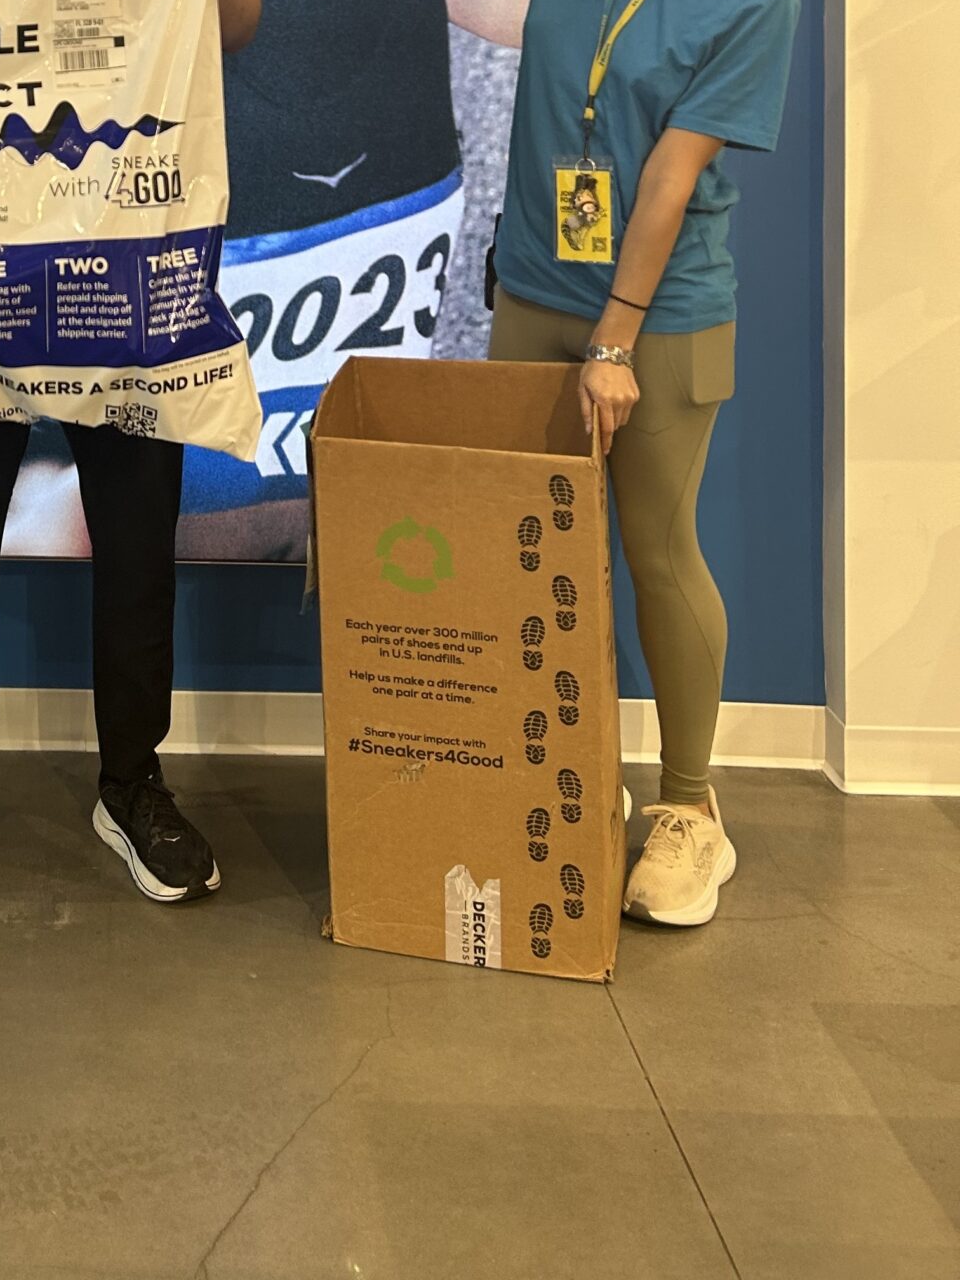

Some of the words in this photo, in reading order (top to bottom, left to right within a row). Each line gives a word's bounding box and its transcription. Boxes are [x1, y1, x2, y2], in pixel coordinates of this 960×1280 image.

[49, 176, 100, 197] with
[55, 256, 109, 275] TWO
[147, 248, 199, 273] TREE
[11, 284, 31, 294] with
[57, 281, 80, 291] Refer
[82, 281, 92, 290] to
[94, 281, 109, 291] the
[12, 295, 21, 304] of
[57, 293, 90, 303] prepaid
[92, 293, 128, 304] shipping
[16, 306, 37, 315] used
[57, 305, 78, 314] label
[80, 305, 96, 314] and
[99, 305, 119, 316] drop
[121, 304, 132, 313] off
[57, 317, 66, 326] at
[68, 317, 83, 326] the
[85, 316, 132, 328] designated
[57, 328, 95, 339] shipping
[89, 382, 103, 395] A
[109, 376, 188, 395] SECOND
[193, 363, 233, 387] LIFE!
[345, 619, 373, 630] Each
[375, 623, 401, 633] year
[404, 627, 430, 635] over
[433, 627, 458, 638] 300
[461, 631, 498, 642] million
[361, 635, 390, 644] pairs
[393, 637, 404, 646] of
[407, 639, 440, 649] shoes
[442, 642, 465, 652] end
[467, 646, 482, 655] up
[379, 648, 389, 657] in
[392, 650, 415, 660] U.S.
[417, 652, 465, 665] landfills.
[350, 670, 375, 683] Help
[377, 674, 390, 682] us
[393, 675, 425, 686] make
[427, 679, 435, 687] a
[437, 679, 498, 693] difference
[372, 686, 393, 695] one
[396, 688, 419, 698] pair
[421, 690, 433, 699] at
[436, 693, 443, 701] a
[446, 693, 475, 704] time.
[364, 726, 396, 739] Share
[398, 732, 422, 742] your
[424, 734, 460, 746] impact
[463, 739, 486, 748] with
[349, 738, 503, 768] #Sneakers4Good
[461, 913, 470, 961] BRANDS
[472, 901, 486, 967] DECKER
